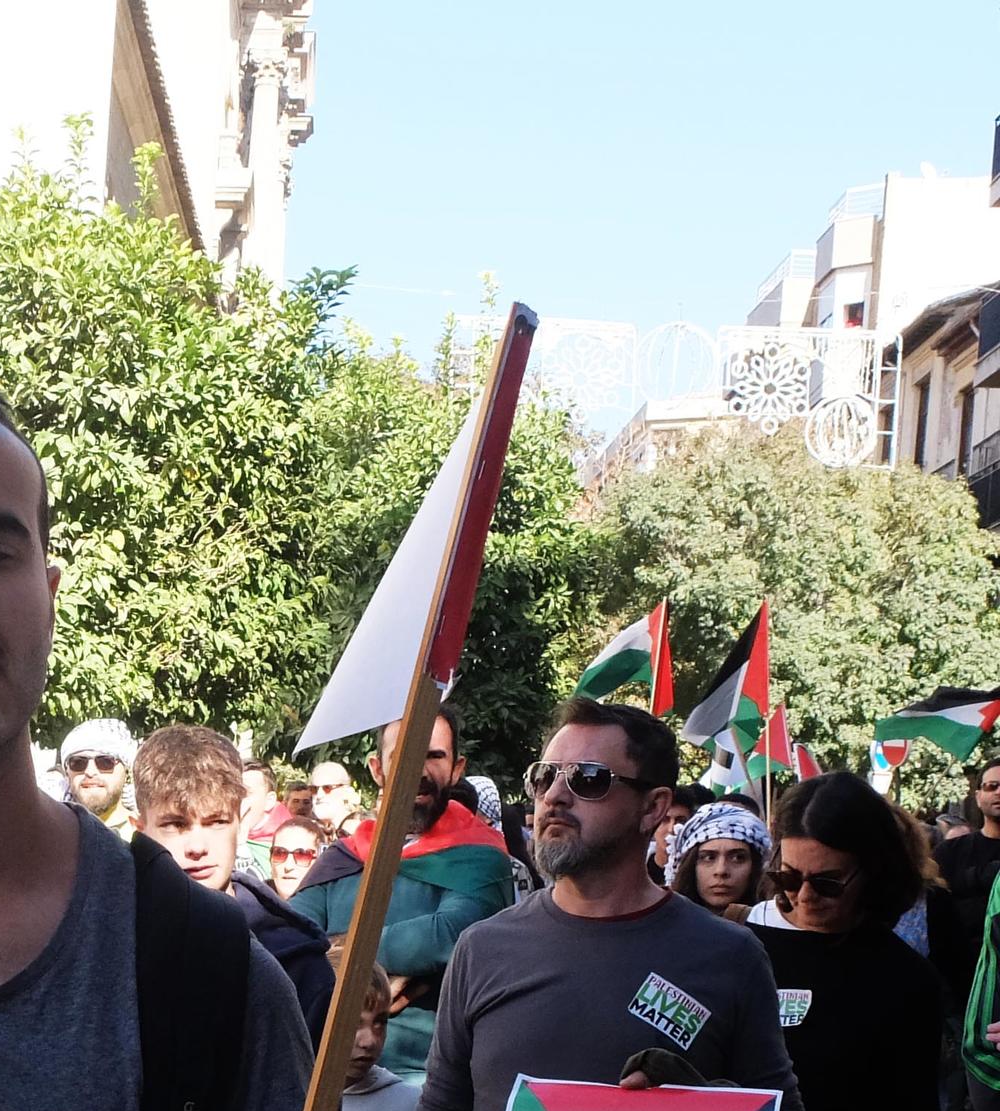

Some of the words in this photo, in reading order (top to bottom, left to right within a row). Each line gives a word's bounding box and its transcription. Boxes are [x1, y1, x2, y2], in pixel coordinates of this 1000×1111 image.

[637, 983, 701, 1034] LIVES
[648, 976, 707, 1019] PALESTINIAN
[630, 998, 691, 1047] MATTER
